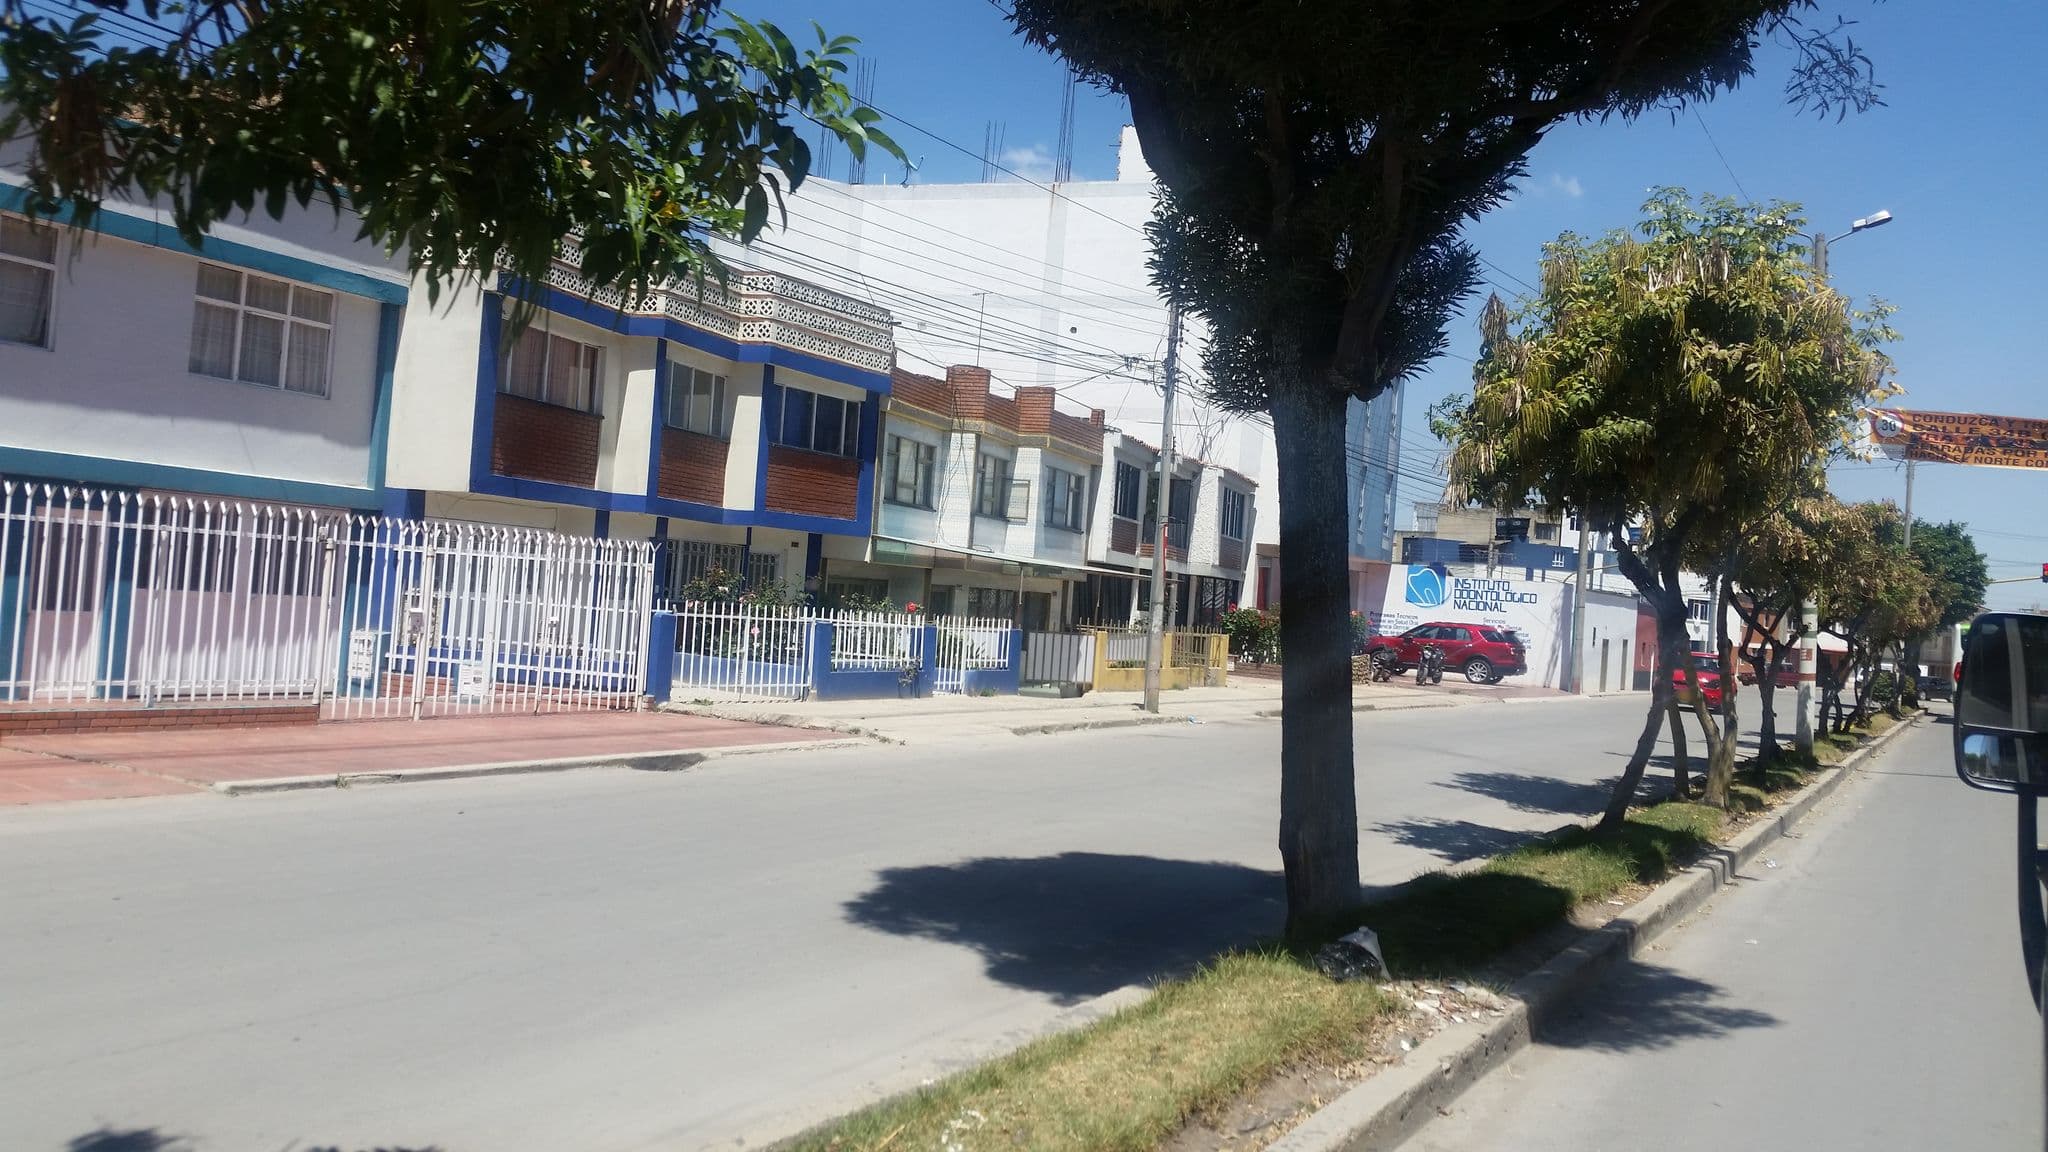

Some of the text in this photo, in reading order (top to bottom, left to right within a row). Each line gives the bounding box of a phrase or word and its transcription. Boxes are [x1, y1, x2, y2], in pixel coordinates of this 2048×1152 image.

[1881, 419, 1897, 431] 30
[1973, 456, 2020, 466] NORTE
[1454, 578, 1510, 591] INSTITUTO
[1453, 600, 1507, 613] NACIONAL
